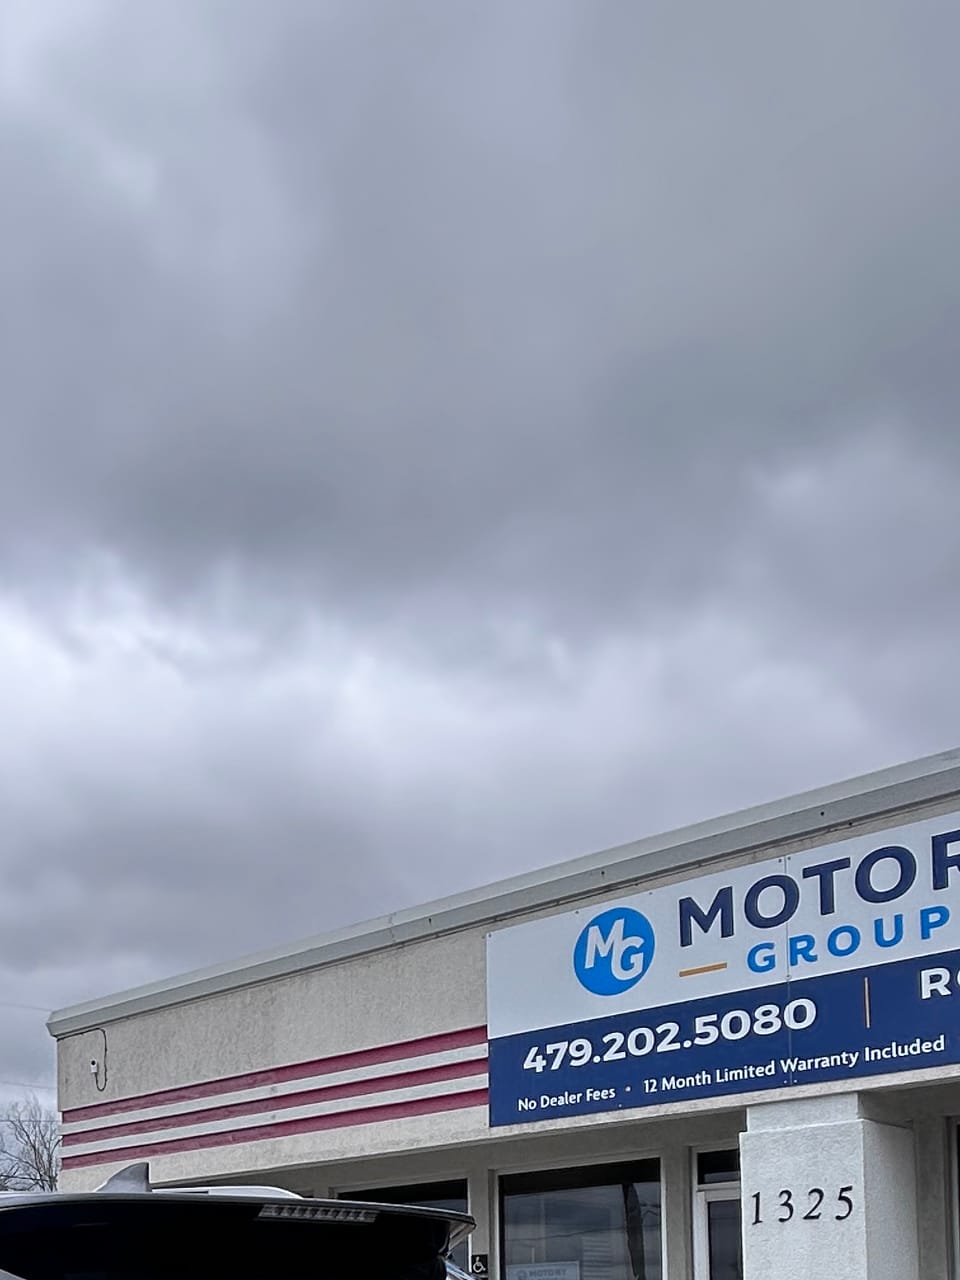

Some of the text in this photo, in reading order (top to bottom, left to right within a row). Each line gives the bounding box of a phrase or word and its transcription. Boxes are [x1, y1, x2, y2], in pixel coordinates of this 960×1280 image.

[583, 917, 645, 981] MG
[746, 905, 950, 973] GROUP
[522, 998, 817, 1073] 479.202.5080
[518, 1034, 946, 1111] No Dealer Fees 12 Month Limited Warranty Included
[751, 1185, 853, 1226] 1325
